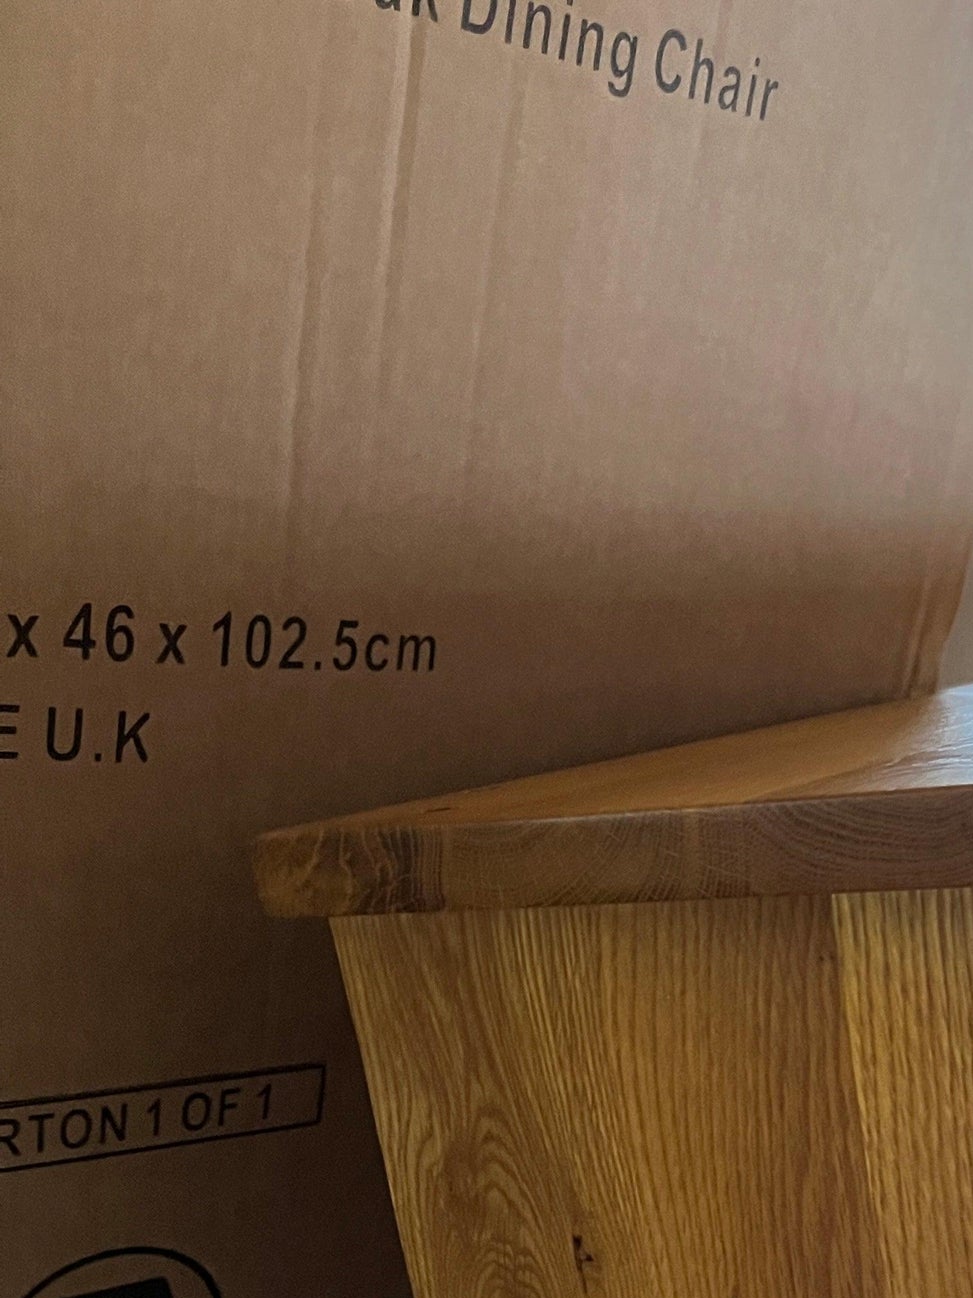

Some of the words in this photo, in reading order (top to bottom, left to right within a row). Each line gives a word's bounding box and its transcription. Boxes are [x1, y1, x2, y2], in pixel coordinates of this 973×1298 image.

[654, 28, 780, 121] Chair
[6, 613, 40, 659] x
[62, 602, 136, 662] 46
[155, 621, 188, 665] x
[212, 610, 437, 673] 102.5cm
[46, 705, 151, 764] U.K
[146, 1097, 162, 1137] 1
[181, 1086, 242, 1132] OF
[256, 1082, 273, 1120] 1
